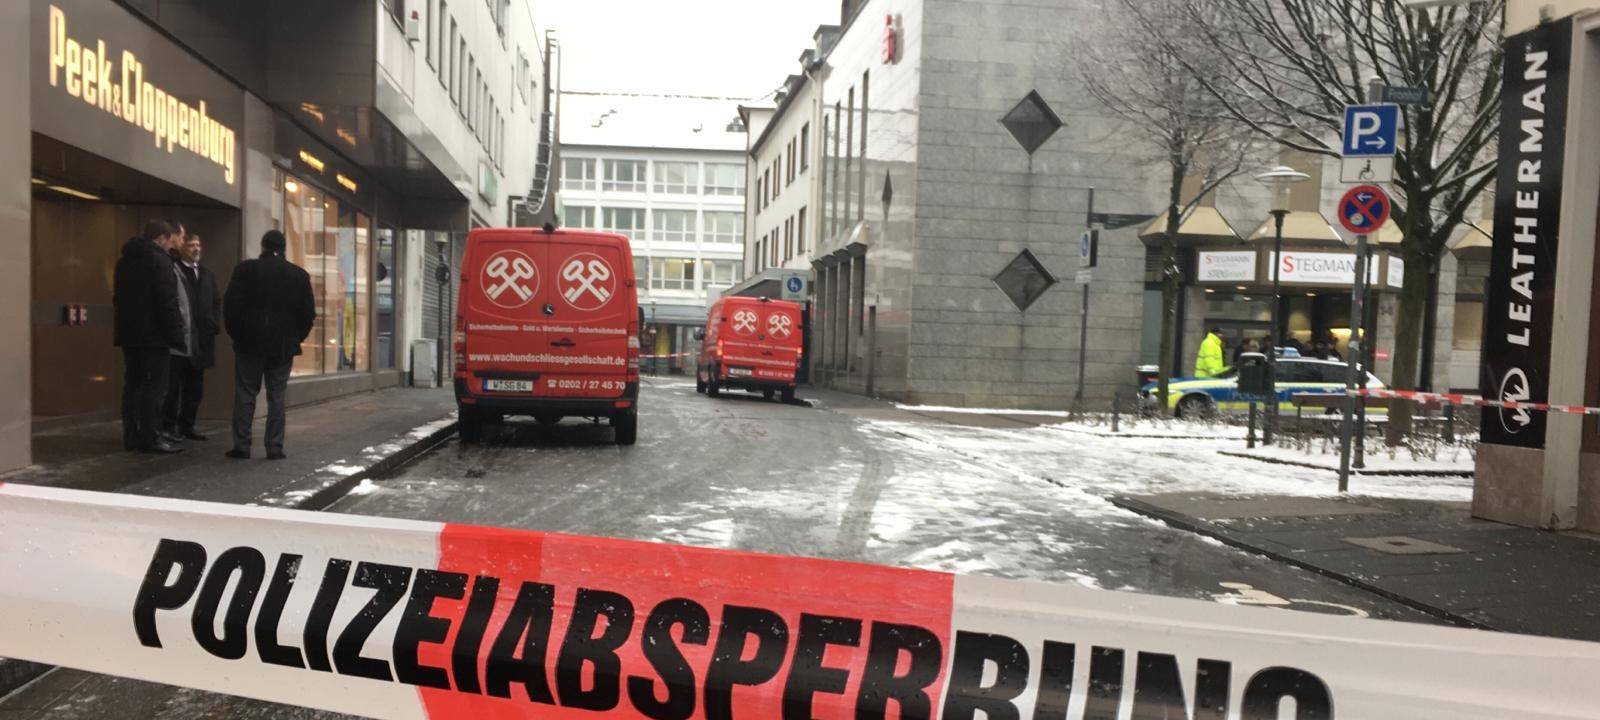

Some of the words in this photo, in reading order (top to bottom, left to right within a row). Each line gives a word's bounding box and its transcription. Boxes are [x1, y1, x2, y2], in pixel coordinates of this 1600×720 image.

[1351, 111, 1381, 150] P
[1507, 51, 1549, 348] LEATHERMAN
[1282, 255, 1357, 274] STEGMAN
[469, 354, 625, 365] www.wachundschliessgesellschaft.de
[558, 379, 580, 389] 0202
[589, 380, 600, 390] 27
[601, 381, 613, 391] 45
[614, 381, 626, 391] 70
